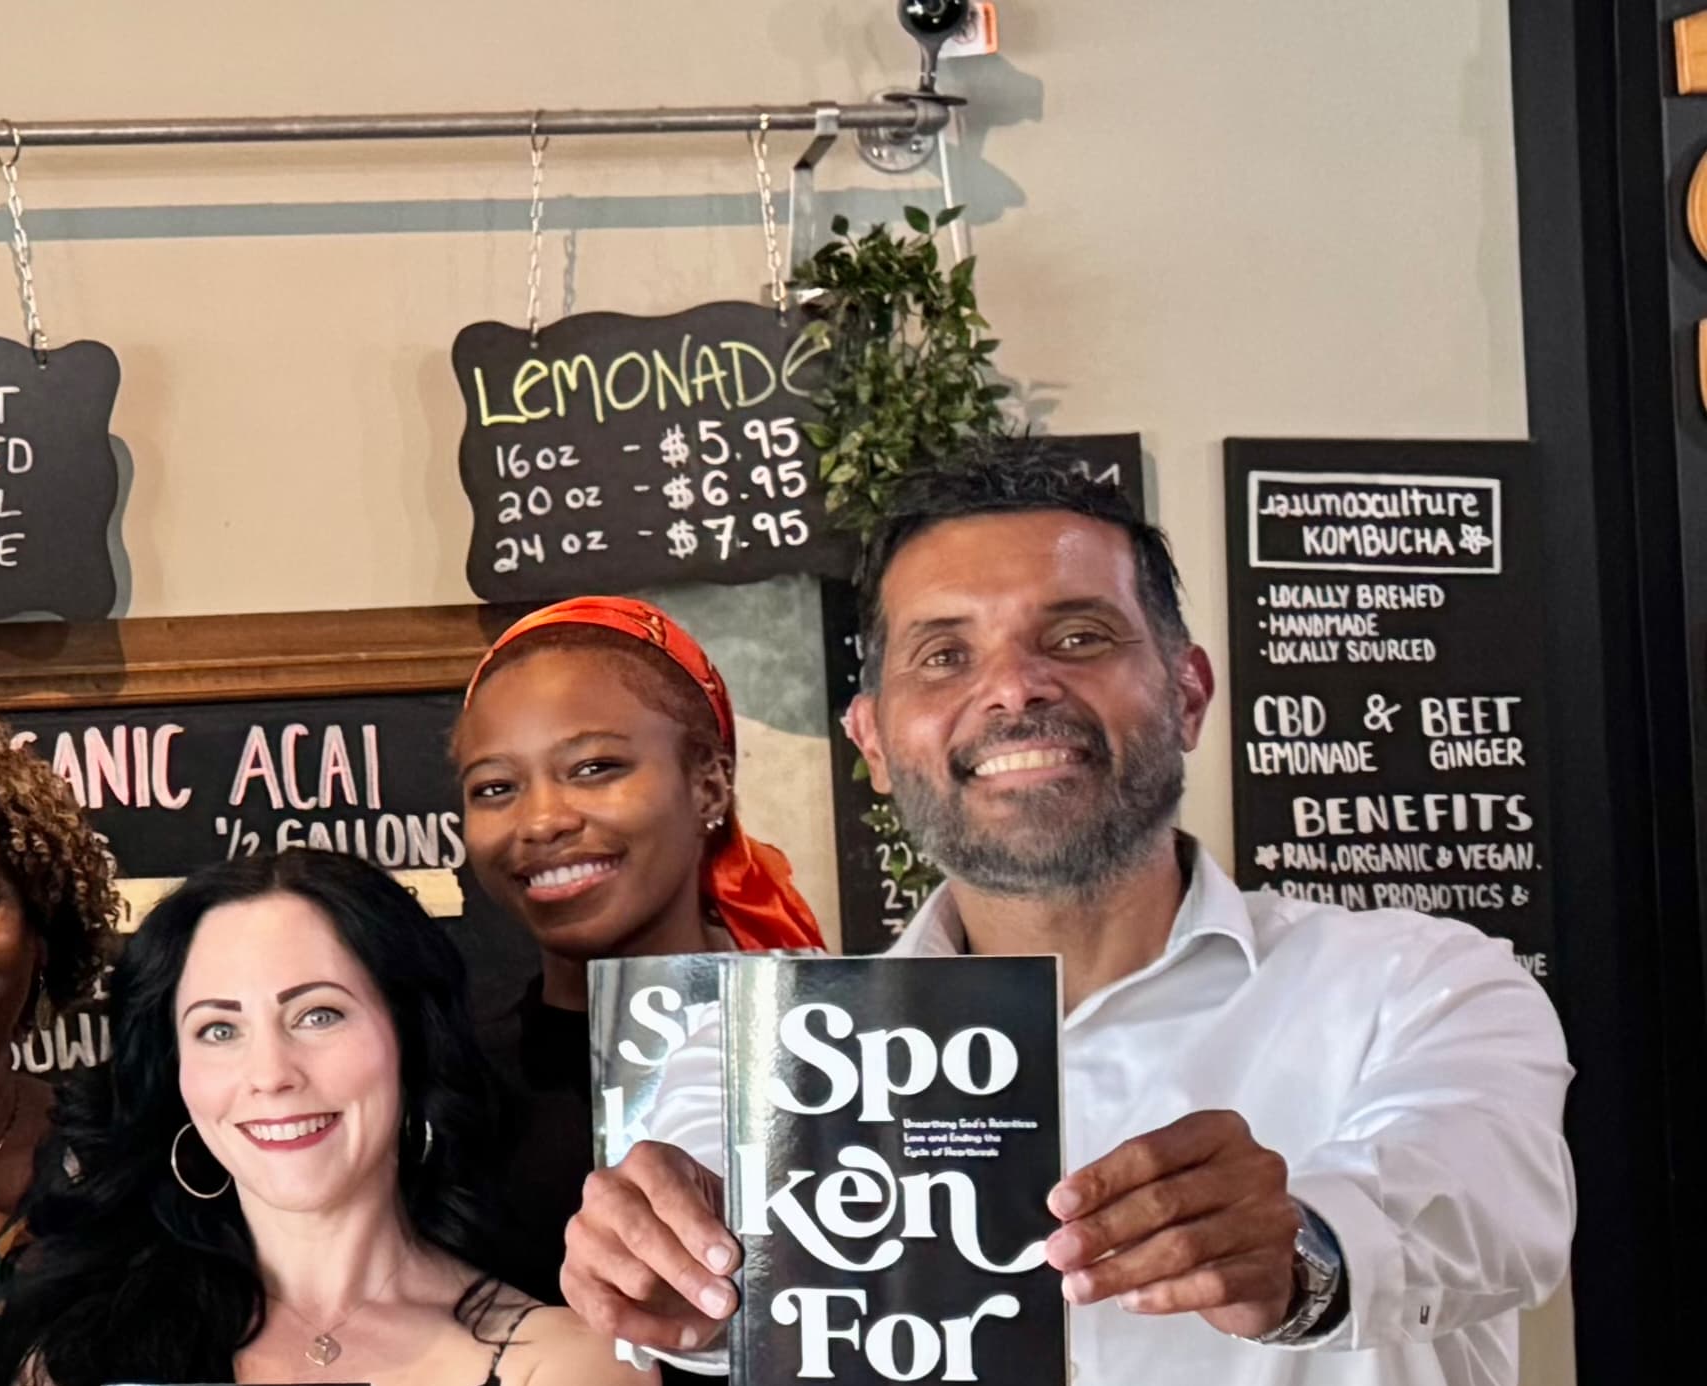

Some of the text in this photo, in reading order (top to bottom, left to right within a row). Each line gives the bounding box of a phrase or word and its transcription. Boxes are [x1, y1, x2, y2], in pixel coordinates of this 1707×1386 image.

[498, 487, 552, 523] 20
[493, 533, 546, 573] 24
[1303, 525, 1455, 557] KOMBUCHA
[1270, 584, 1445, 609] LOCALLY BREWED
[1269, 613, 1379, 638] HANDMADE
[1269, 638, 1436, 664] LOCALLY SOURCED
[1253, 695, 1326, 737] CBD
[1420, 696, 1522, 737] BEET
[10, 723, 381, 810] ANIC ACAI
[1246, 738, 1526, 775] LEMONADE GINGER
[1293, 793, 1533, 838] BENEFITS
[1375, 882, 1504, 913] PROBIOTICS
[768, 1002, 1019, 1122] Spo
[735, 1145, 1049, 1274] ken
[771, 1288, 1020, 1382] For
